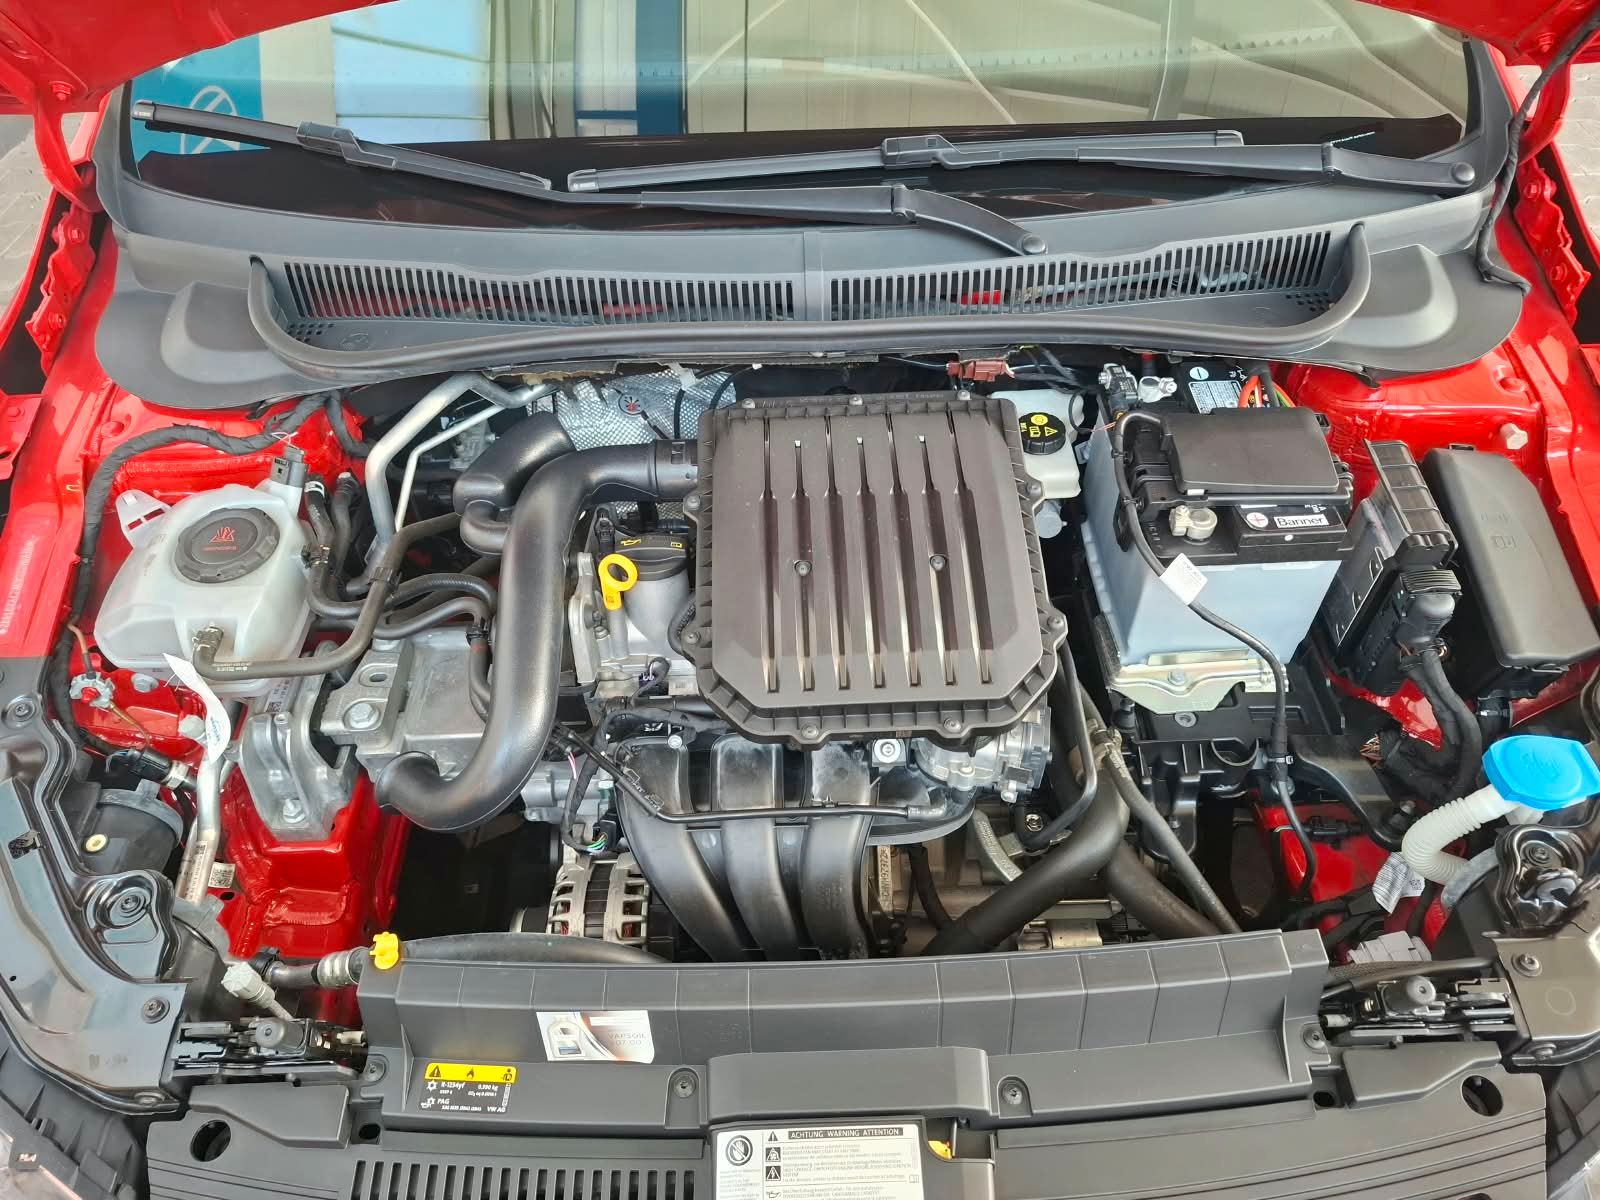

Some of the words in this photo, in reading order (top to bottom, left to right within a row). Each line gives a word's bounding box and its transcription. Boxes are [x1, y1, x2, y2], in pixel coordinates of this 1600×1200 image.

[1276, 516, 1324, 526] Banner
[441, 1082, 466, 1090] R-1234yf
[790, 1129, 824, 1139] ACHTUNG
[827, 1128, 860, 1137] WARNING
[862, 1128, 899, 1136] ATTENTION
